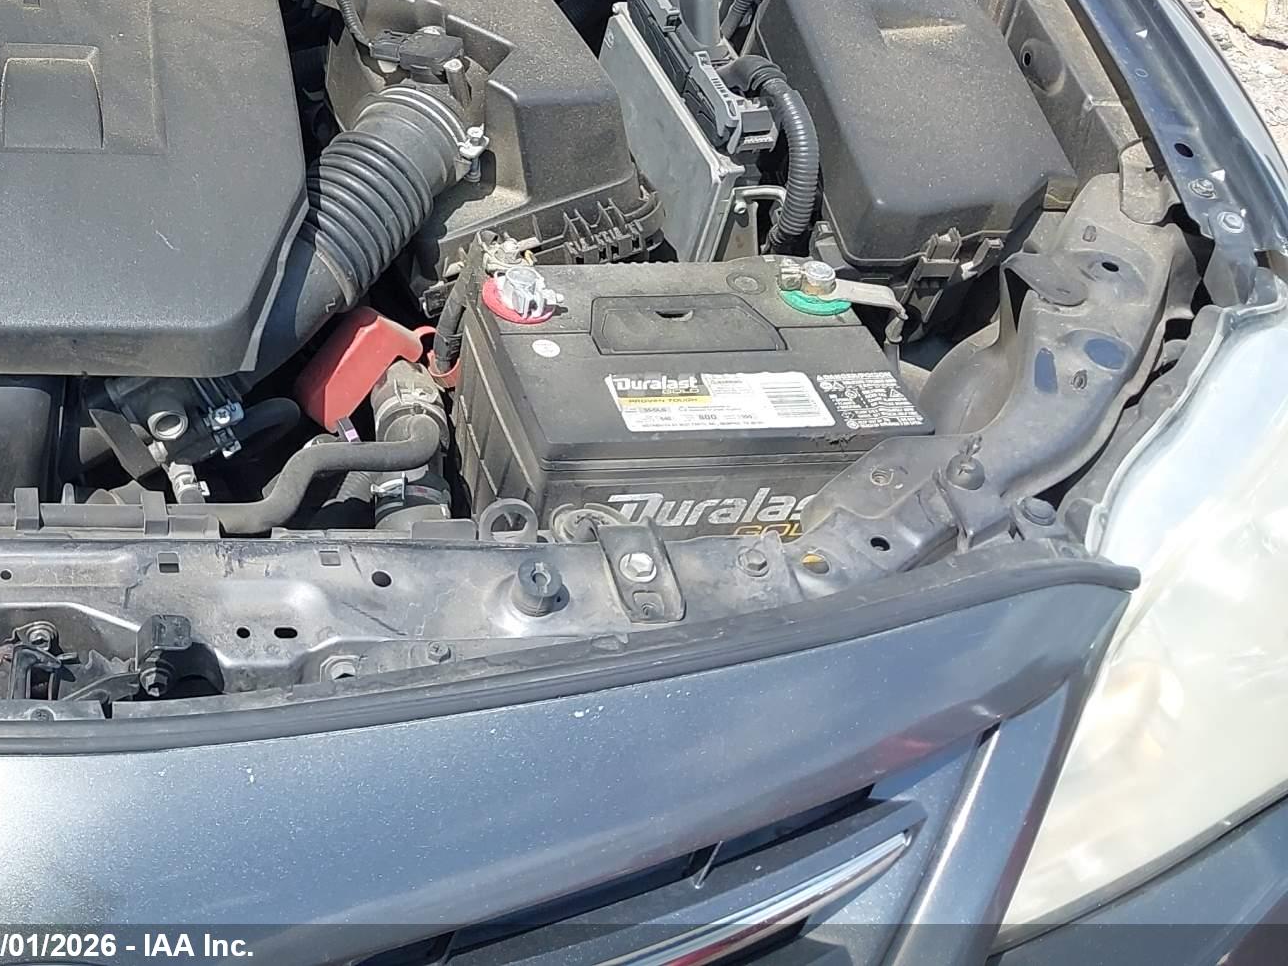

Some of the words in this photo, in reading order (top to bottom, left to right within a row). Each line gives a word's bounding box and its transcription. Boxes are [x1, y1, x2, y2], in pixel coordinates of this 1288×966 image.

[612, 375, 699, 391] Duralast
[608, 487, 816, 527] Duralas
[733, 523, 804, 537] GOL
